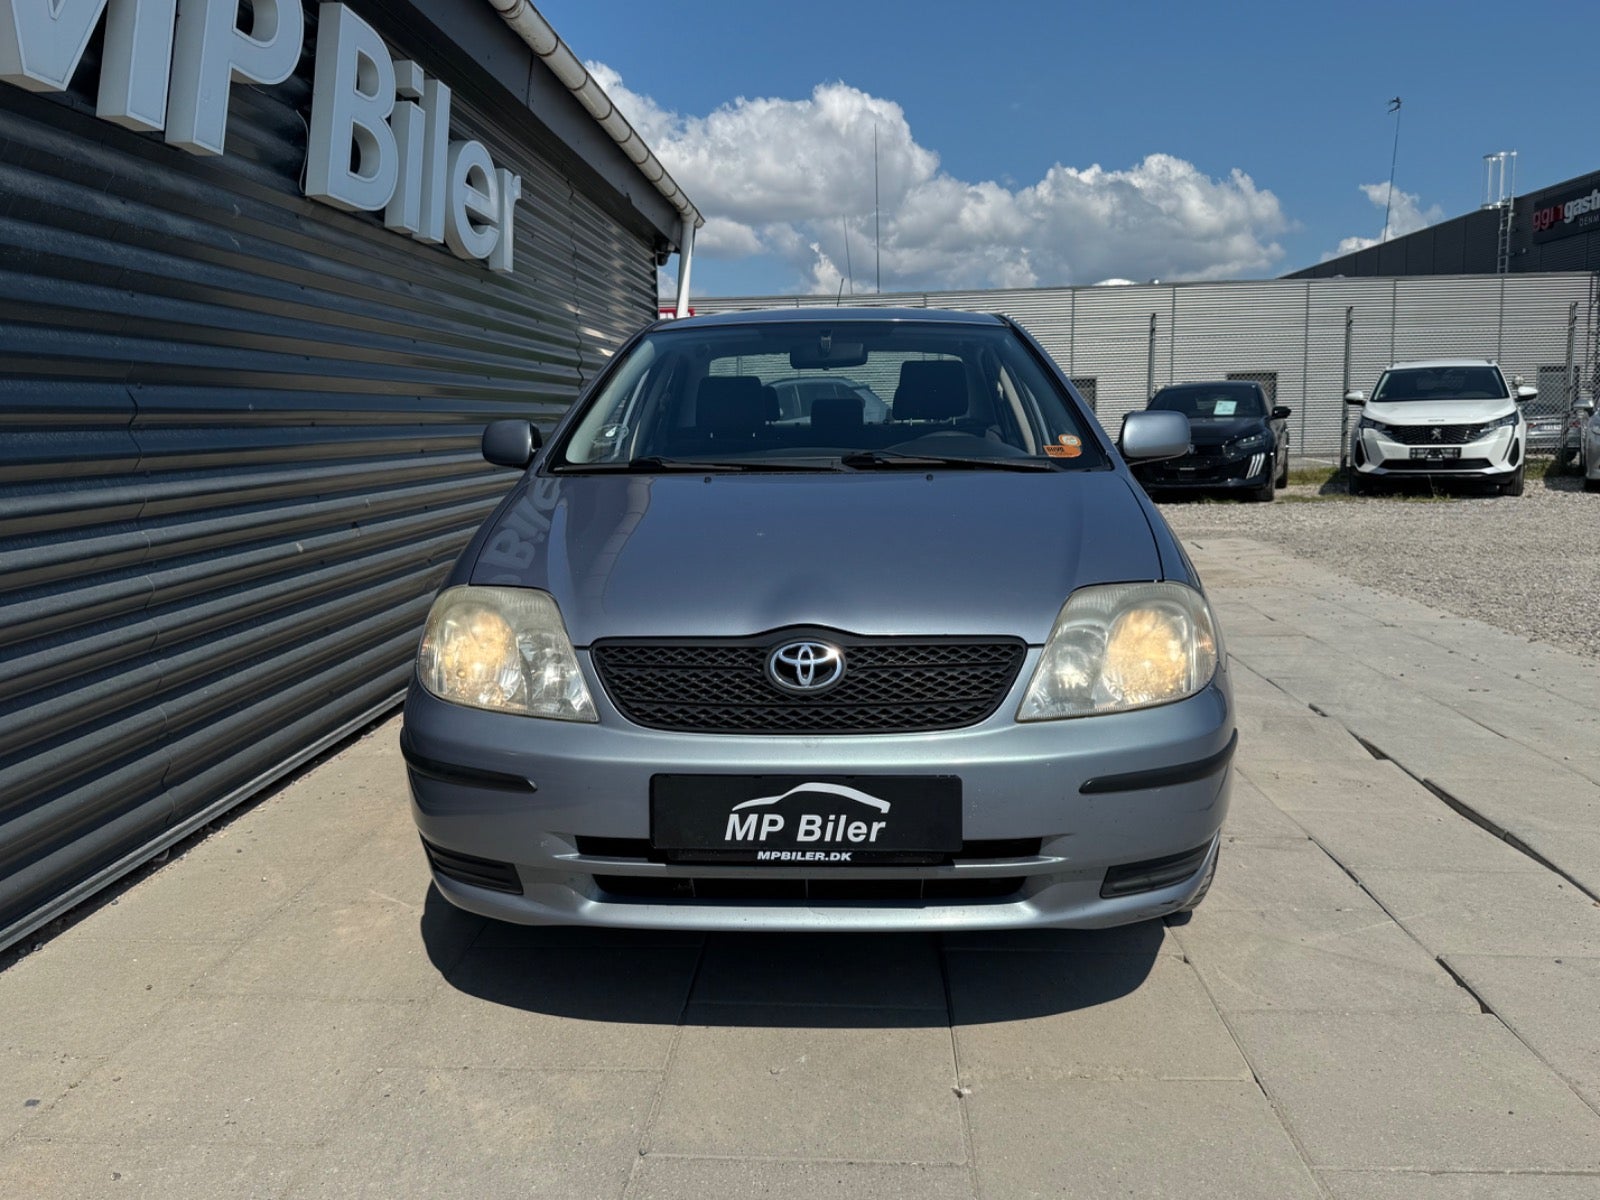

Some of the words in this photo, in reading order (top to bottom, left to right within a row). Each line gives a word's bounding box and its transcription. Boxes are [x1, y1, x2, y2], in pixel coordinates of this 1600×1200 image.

[305, 2, 522, 273] Biler
[724, 813, 785, 841] MP
[796, 814, 887, 843] Biler
[756, 850, 853, 862] MPBILER.DK
